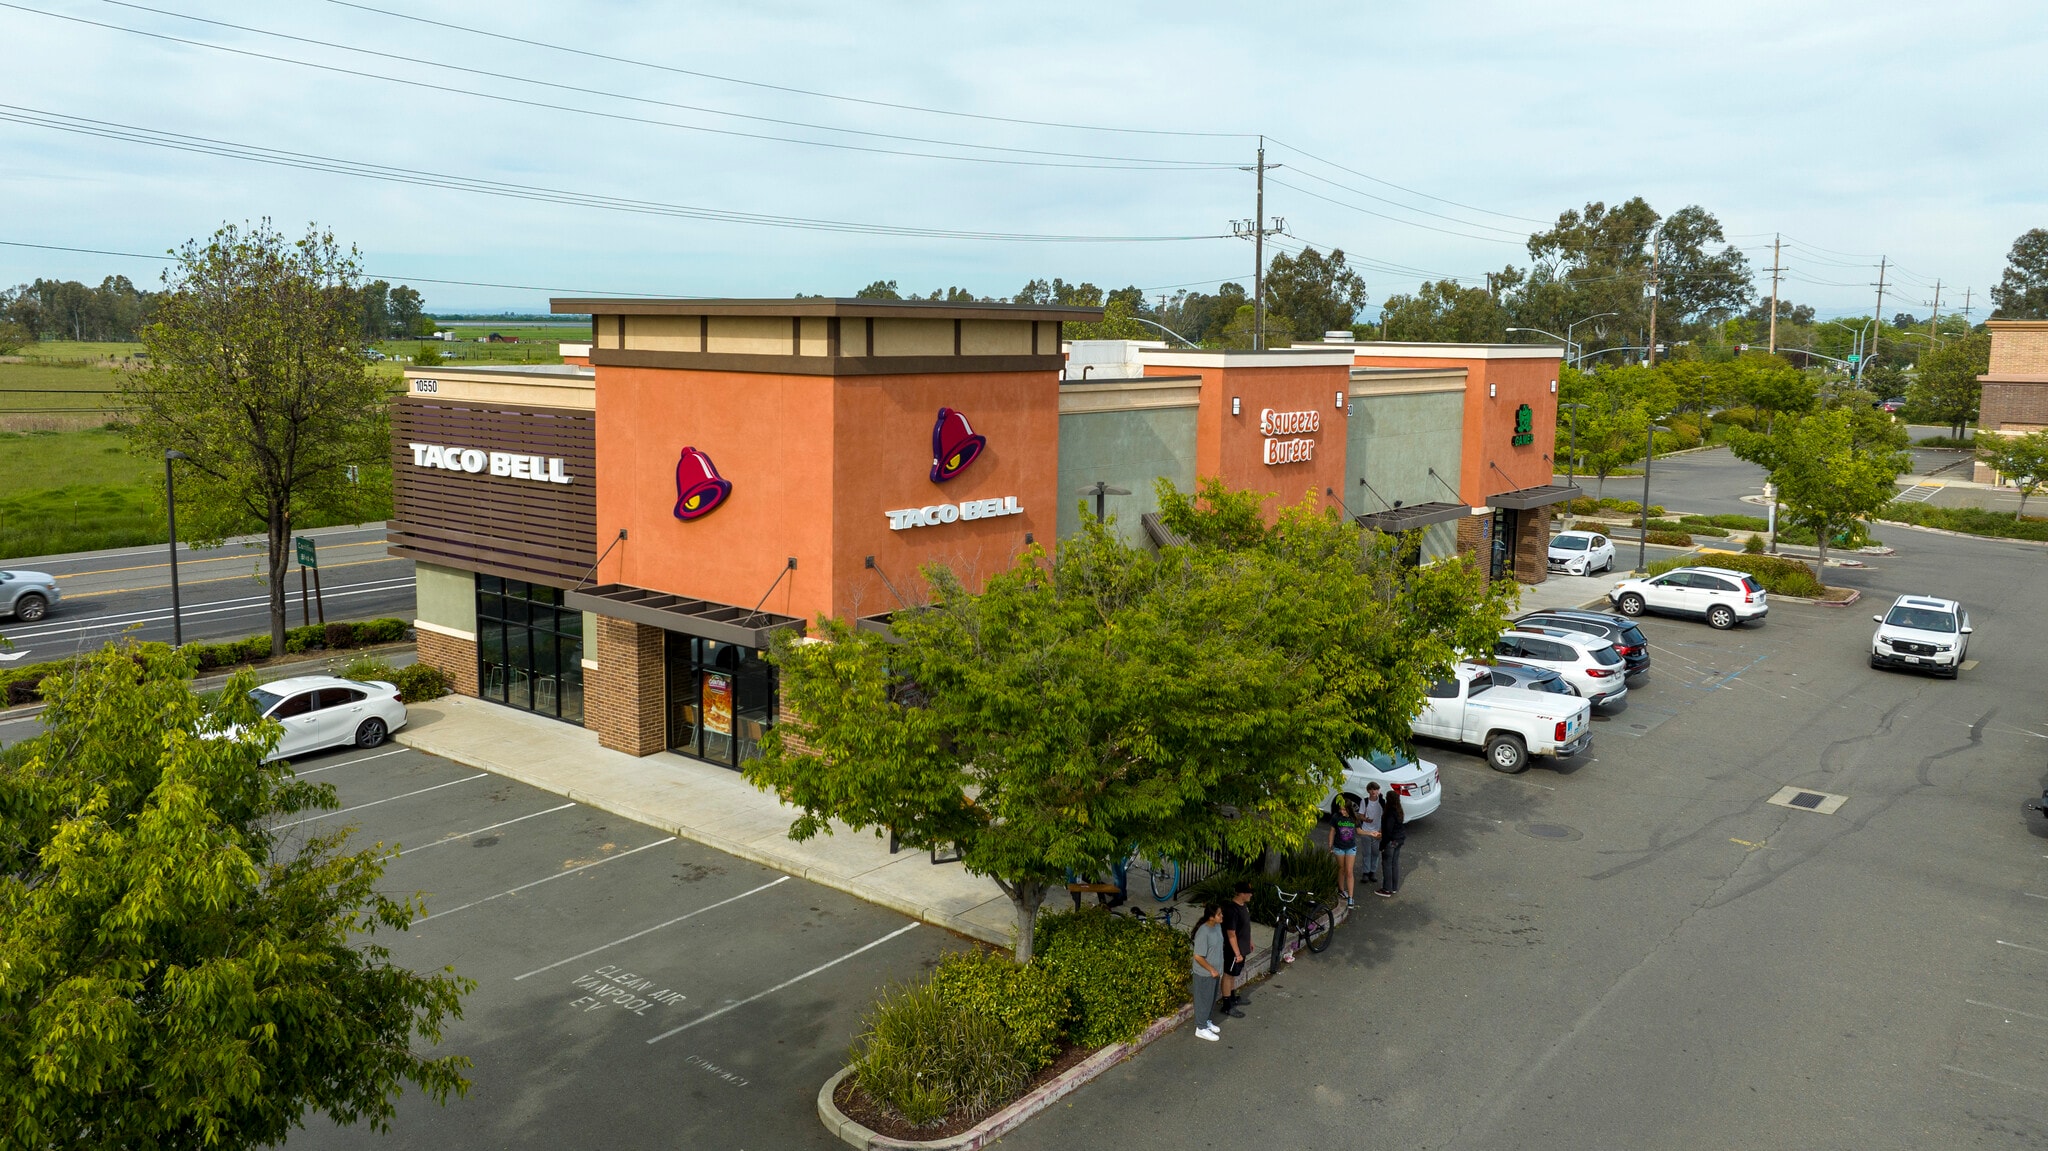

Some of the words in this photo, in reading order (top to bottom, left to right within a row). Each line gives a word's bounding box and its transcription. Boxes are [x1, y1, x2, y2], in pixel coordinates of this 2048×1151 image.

[415, 380, 437, 392] 10550
[1260, 409, 1320, 436] Squeeze
[409, 443, 487, 473] TACO
[489, 451, 574, 484] BELL
[1264, 438, 1315, 465] Burger
[885, 503, 960, 530] TACO
[959, 496, 1024, 521] BELL
[571, 974, 654, 1016] VANPOOL
[594, 965, 656, 991] CLEAN
[648, 989, 687, 1006] AIR
[569, 996, 607, 1012] EV
